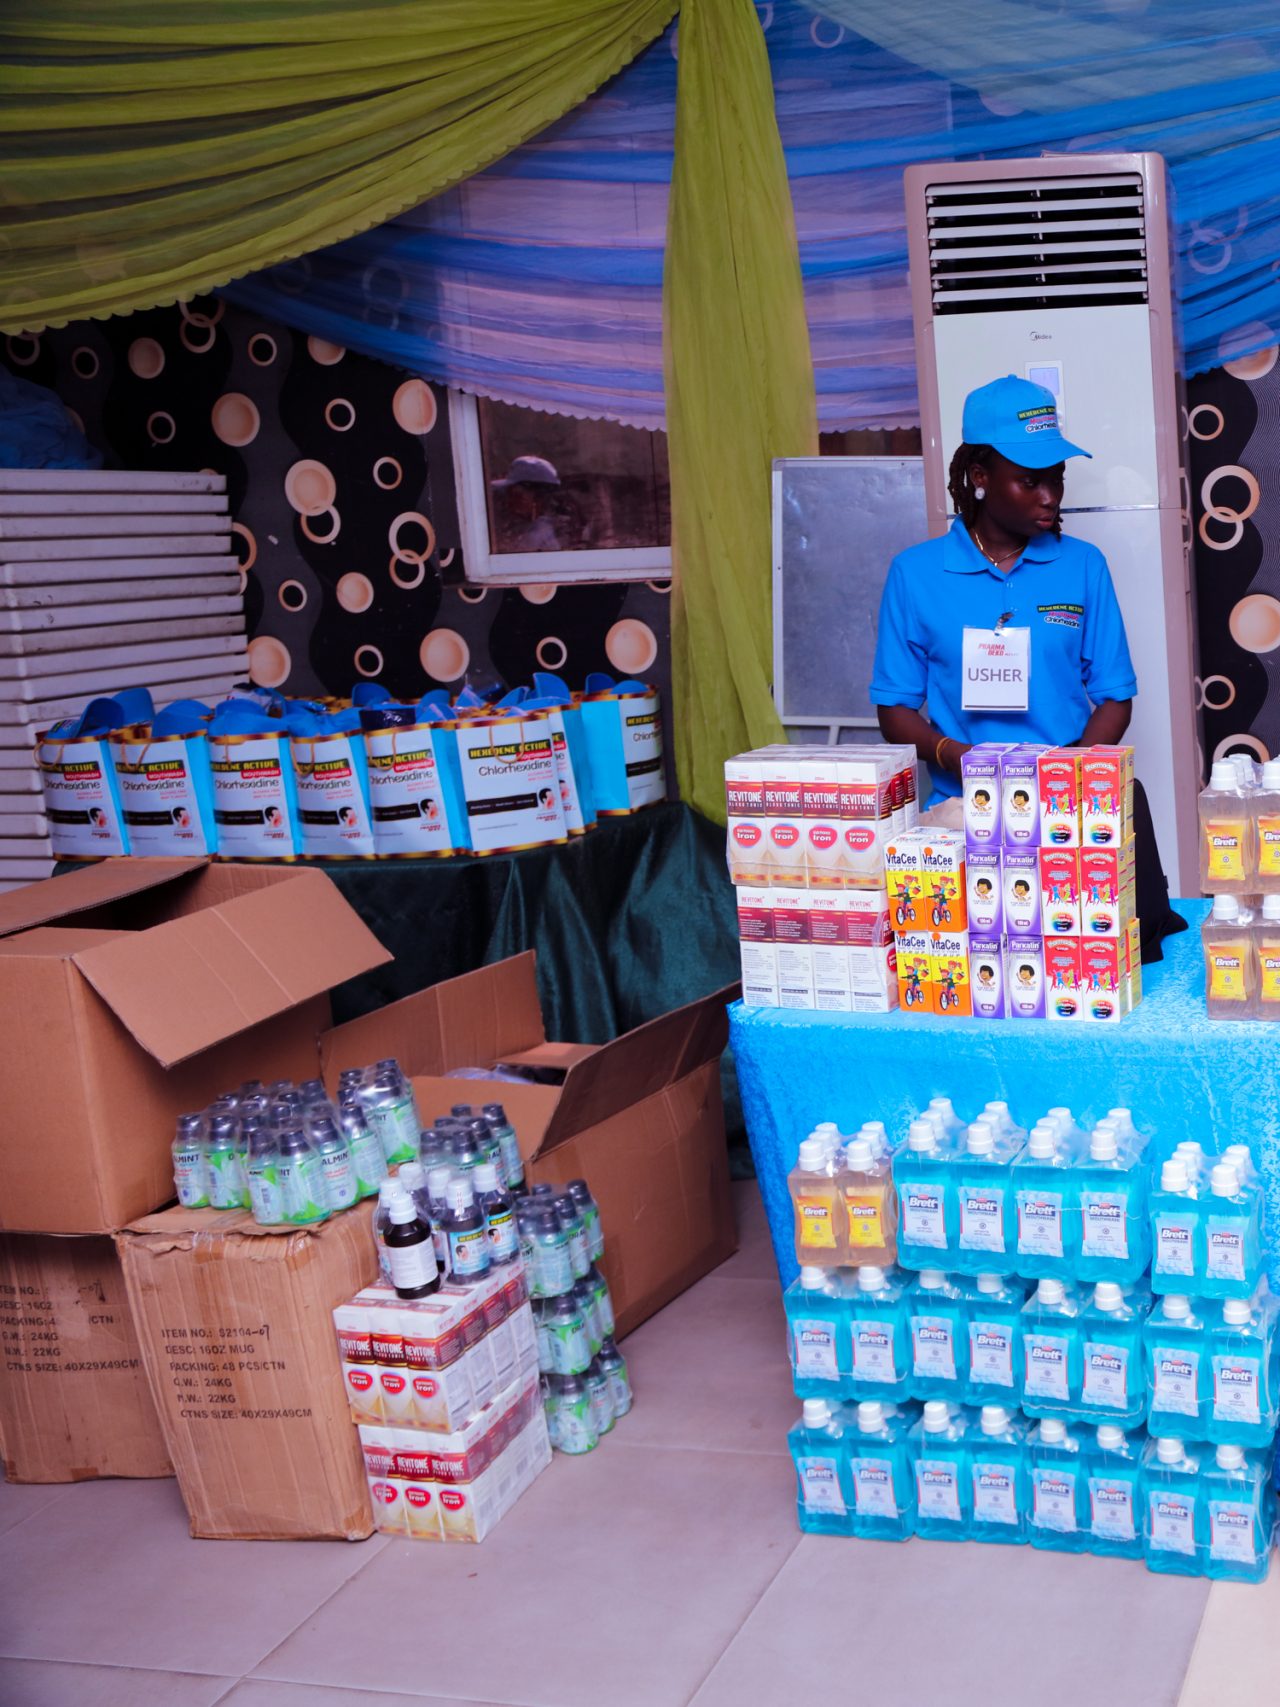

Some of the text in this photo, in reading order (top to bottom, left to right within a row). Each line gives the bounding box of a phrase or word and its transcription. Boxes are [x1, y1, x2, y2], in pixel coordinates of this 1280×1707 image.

[968, 668, 1022, 682] USHER
[479, 759, 552, 776] Chlorhexidine
[122, 780, 185, 791] Chlorhexidine
[1213, 837, 1238, 846] Brett
[886, 853, 917, 864] VitaCee
[922, 854, 952, 865] VitaCee
[896, 936, 926, 947] VitaCee
[930, 938, 960, 950] VitaCee
[1216, 958, 1239, 967] Brett
[909, 1197, 938, 1208] Brett
[967, 1199, 997, 1210] Brett
[804, 1207, 828, 1216] Brett
[852, 1207, 876, 1216] Brett
[1025, 1204, 1055, 1215] Brett
[1089, 1205, 1121, 1216] Brett
[1162, 1229, 1188, 1239] Brett
[1212, 1233, 1239, 1244] Brett
[161, 1329, 187, 1338] ITEM
[802, 1332, 830, 1343] Brett
[859, 1333, 888, 1344] Brett
[919, 1329, 948, 1339] Brett
[977, 1335, 1006, 1346] Brett
[33, 1348, 61, 1356] 22KG
[166, 1346, 195, 1354] DESC:
[229, 1344, 255, 1354] MUG
[1032, 1348, 1062, 1359] Brett
[35, 1363, 62, 1372] SIZE:
[64, 1359, 139, 1371] 40X29X49CM
[170, 1361, 285, 1371] PACKING: 48 PCS/CTN
[1091, 1355, 1121, 1367] Brett
[1161, 1361, 1191, 1373] Brett
[1221, 1368, 1252, 1381] Brett
[204, 1378, 232, 1387] 24KG
[351, 1377, 368, 1385] Iron
[416, 1384, 433, 1392] Iron
[208, 1394, 236, 1403] 22KG
[181, 1409, 312, 1419] CTNS SIZE: 40X29X49CM
[806, 1469, 833, 1479] Brett
[860, 1470, 888, 1480] Brett
[924, 1472, 951, 1482] Brett
[980, 1475, 1009, 1486] Brett
[1040, 1481, 1069, 1493] Brett
[375, 1489, 393, 1498] Iron
[408, 1493, 426, 1502] Iron
[1097, 1490, 1126, 1501] Brett
[442, 1496, 461, 1505] Iron
[1158, 1503, 1187, 1515] Brett
[1218, 1512, 1248, 1524] Brett
